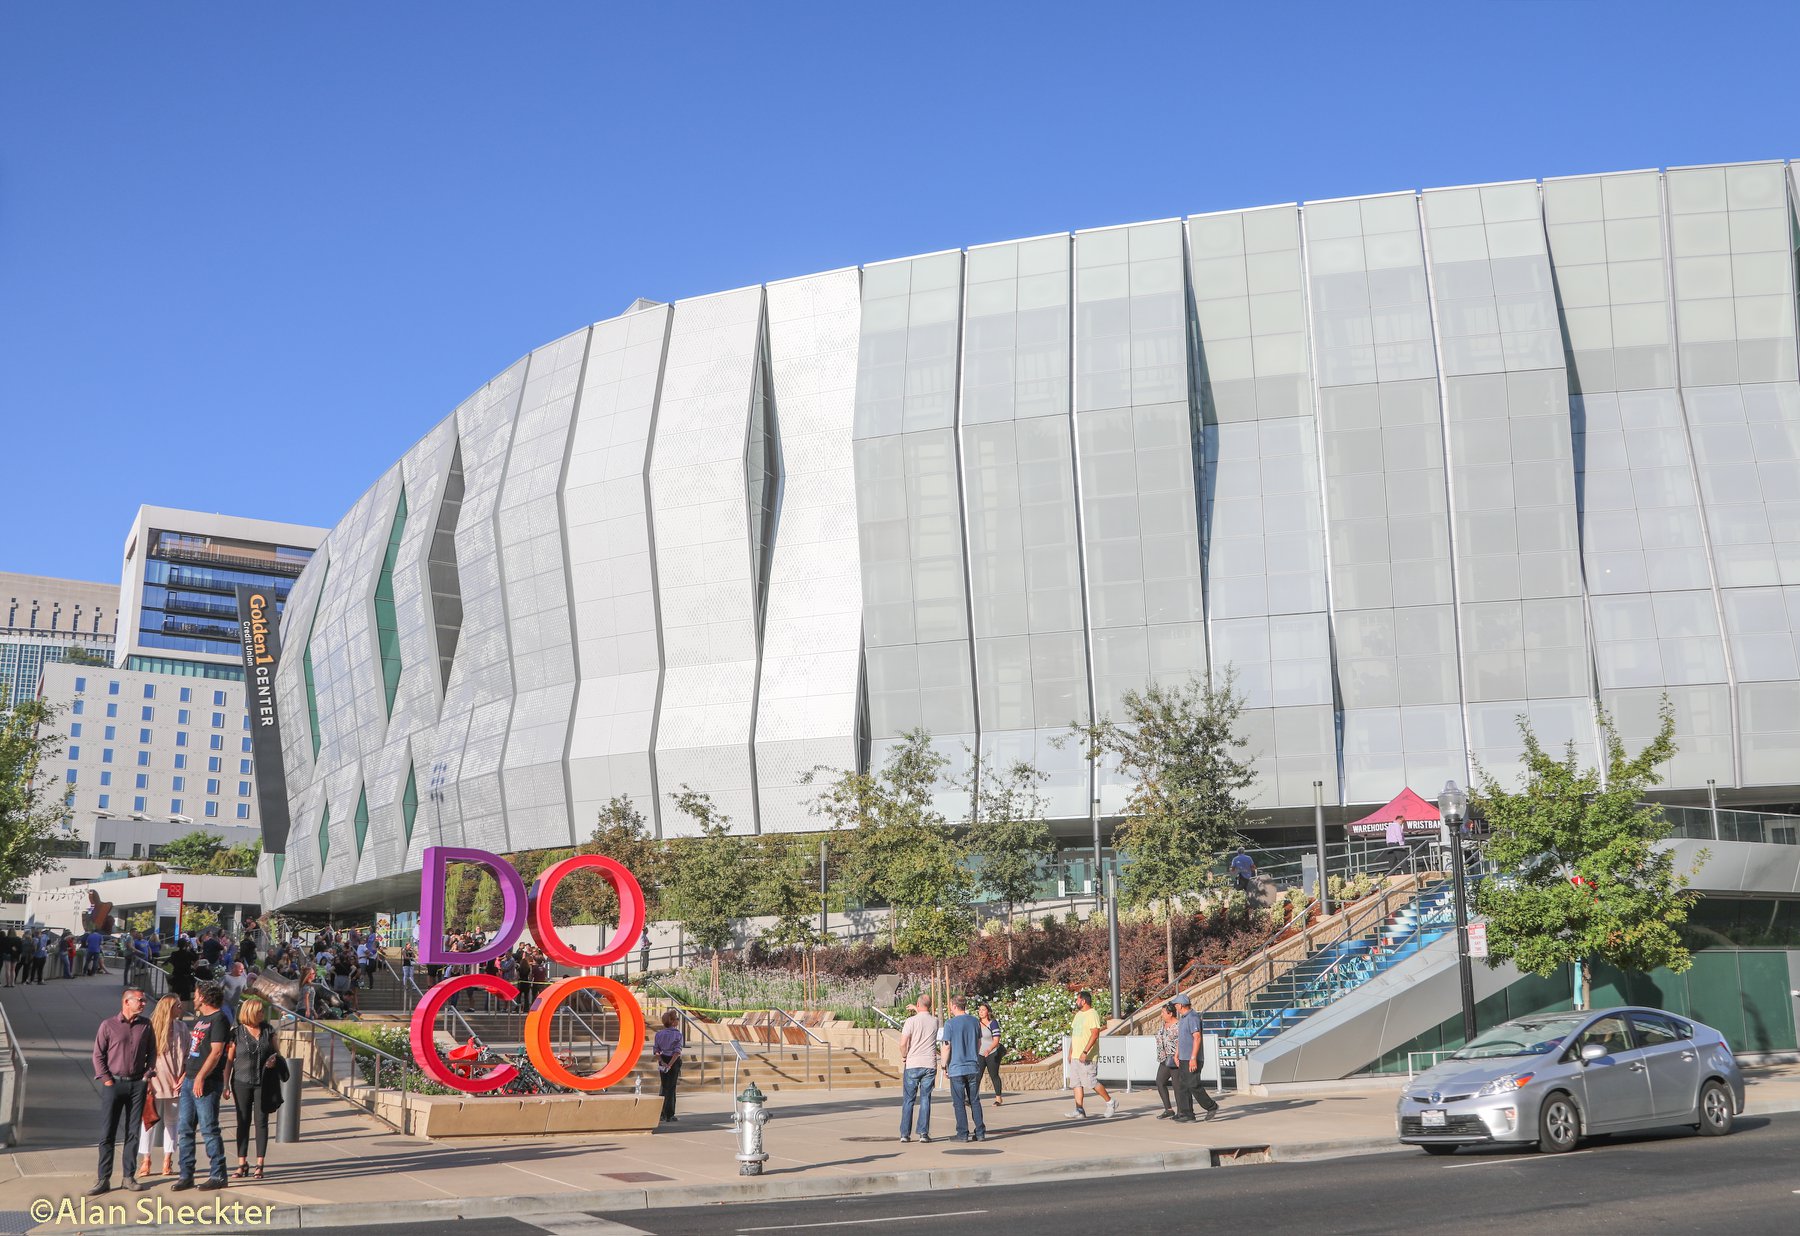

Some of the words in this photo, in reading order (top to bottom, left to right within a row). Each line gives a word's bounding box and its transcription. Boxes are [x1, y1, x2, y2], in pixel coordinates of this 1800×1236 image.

[243, 621, 253, 644] Credit
[250, 594, 269, 655] Golden
[246, 645, 254, 667] Union
[256, 667, 274, 726] CENTER
